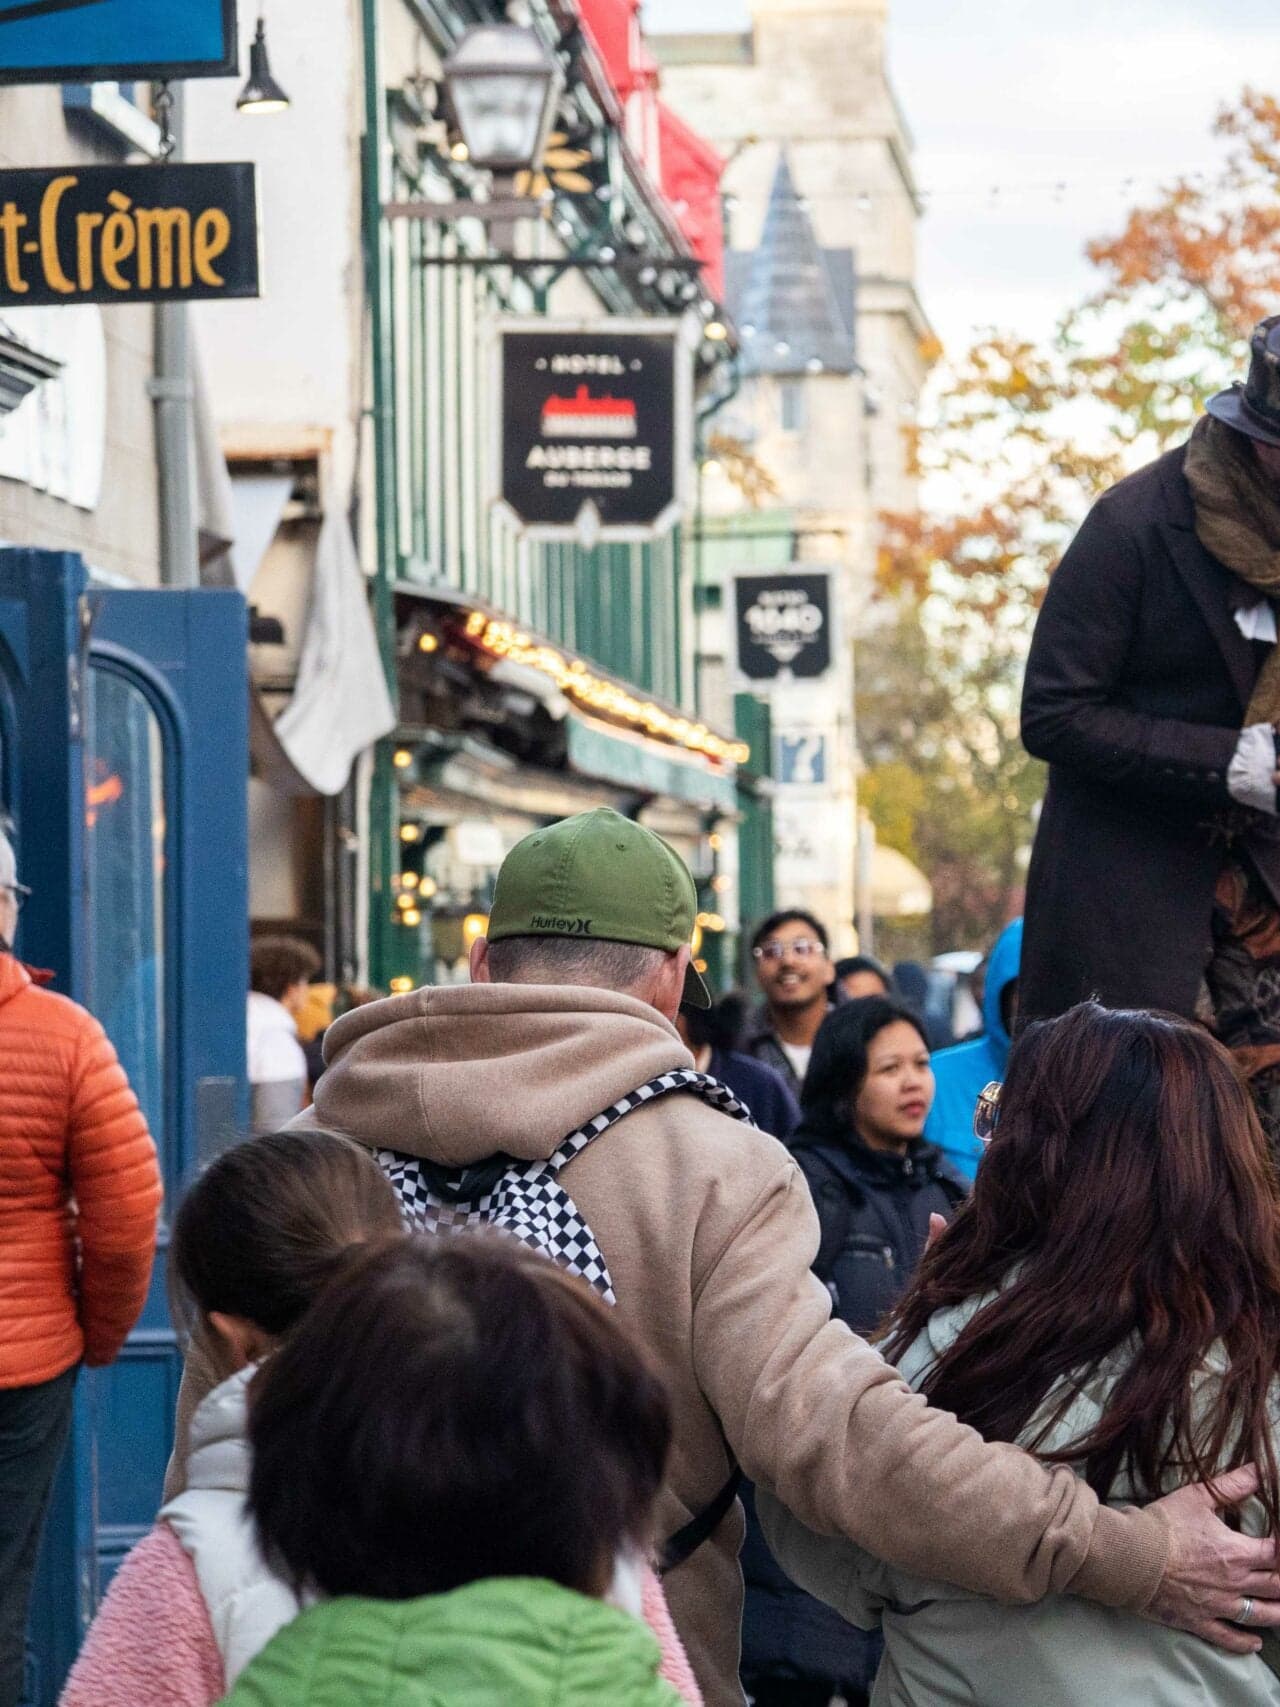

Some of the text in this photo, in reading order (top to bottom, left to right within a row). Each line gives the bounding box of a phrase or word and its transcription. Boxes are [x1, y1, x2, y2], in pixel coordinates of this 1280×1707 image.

[0, 175, 231, 294] t-Crème
[526, 445, 651, 470] AUBERGE
[530, 916, 576, 933] Hurley
